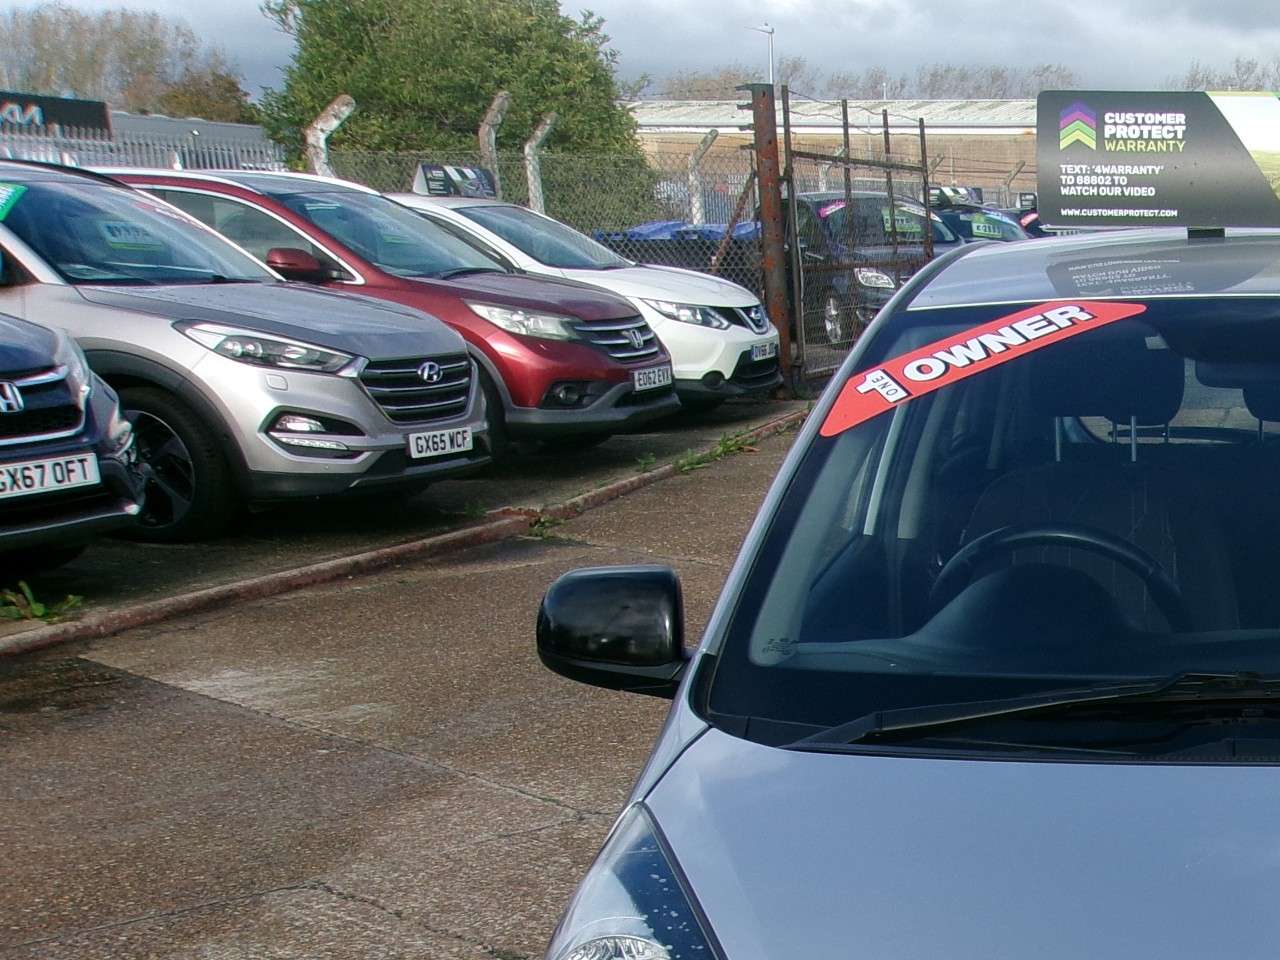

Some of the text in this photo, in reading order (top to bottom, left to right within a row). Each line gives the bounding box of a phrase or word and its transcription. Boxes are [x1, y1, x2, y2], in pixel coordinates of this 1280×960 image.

[1104, 112, 1186, 124] CUSTOMER
[1104, 125, 1186, 139] PROTECT
[1105, 140, 1186, 152] WARRANTY
[1060, 164, 1090, 174] TEXT:
[1060, 175, 1074, 185] TO
[1113, 176, 1128, 186] TO
[1061, 187, 1156, 197] WATCH OUR VIDEO
[1061, 208, 1178, 217] WWW.CUSTOMERPROTECT.COM
[903, 304, 1097, 382] OWNER
[415, 430, 468, 454] GX65 WCF
[0, 457, 89, 492] GX67 OFT
